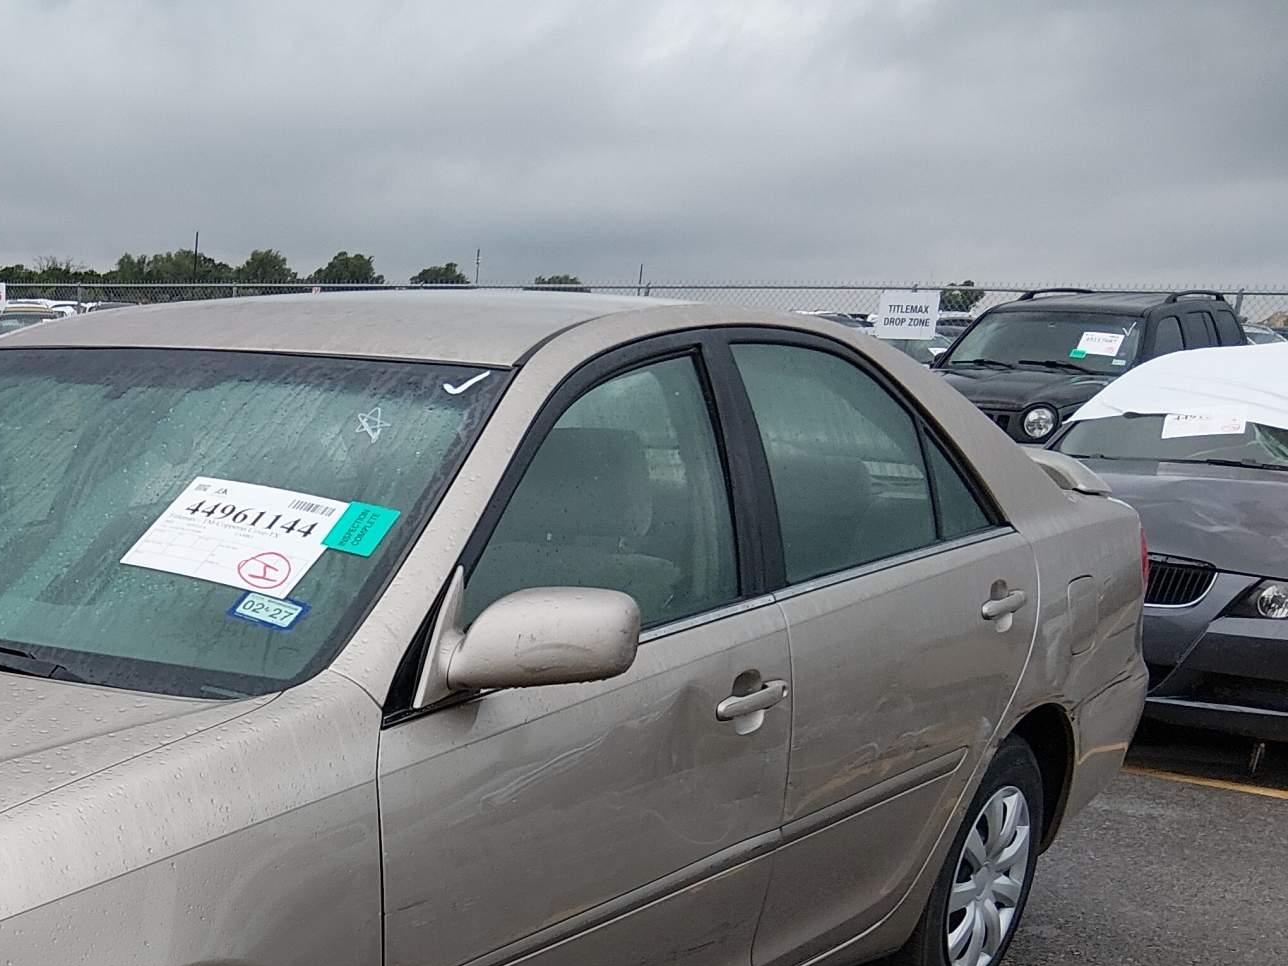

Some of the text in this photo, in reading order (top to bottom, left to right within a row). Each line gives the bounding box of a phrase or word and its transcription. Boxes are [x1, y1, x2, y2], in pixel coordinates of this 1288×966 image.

[883, 317, 931, 327] DROP ZONE
[888, 304, 930, 314] TITLEMAX
[185, 499, 319, 538] 44961144
[337, 508, 371, 547] INSPECTION
[350, 511, 380, 546] COMPLETE
